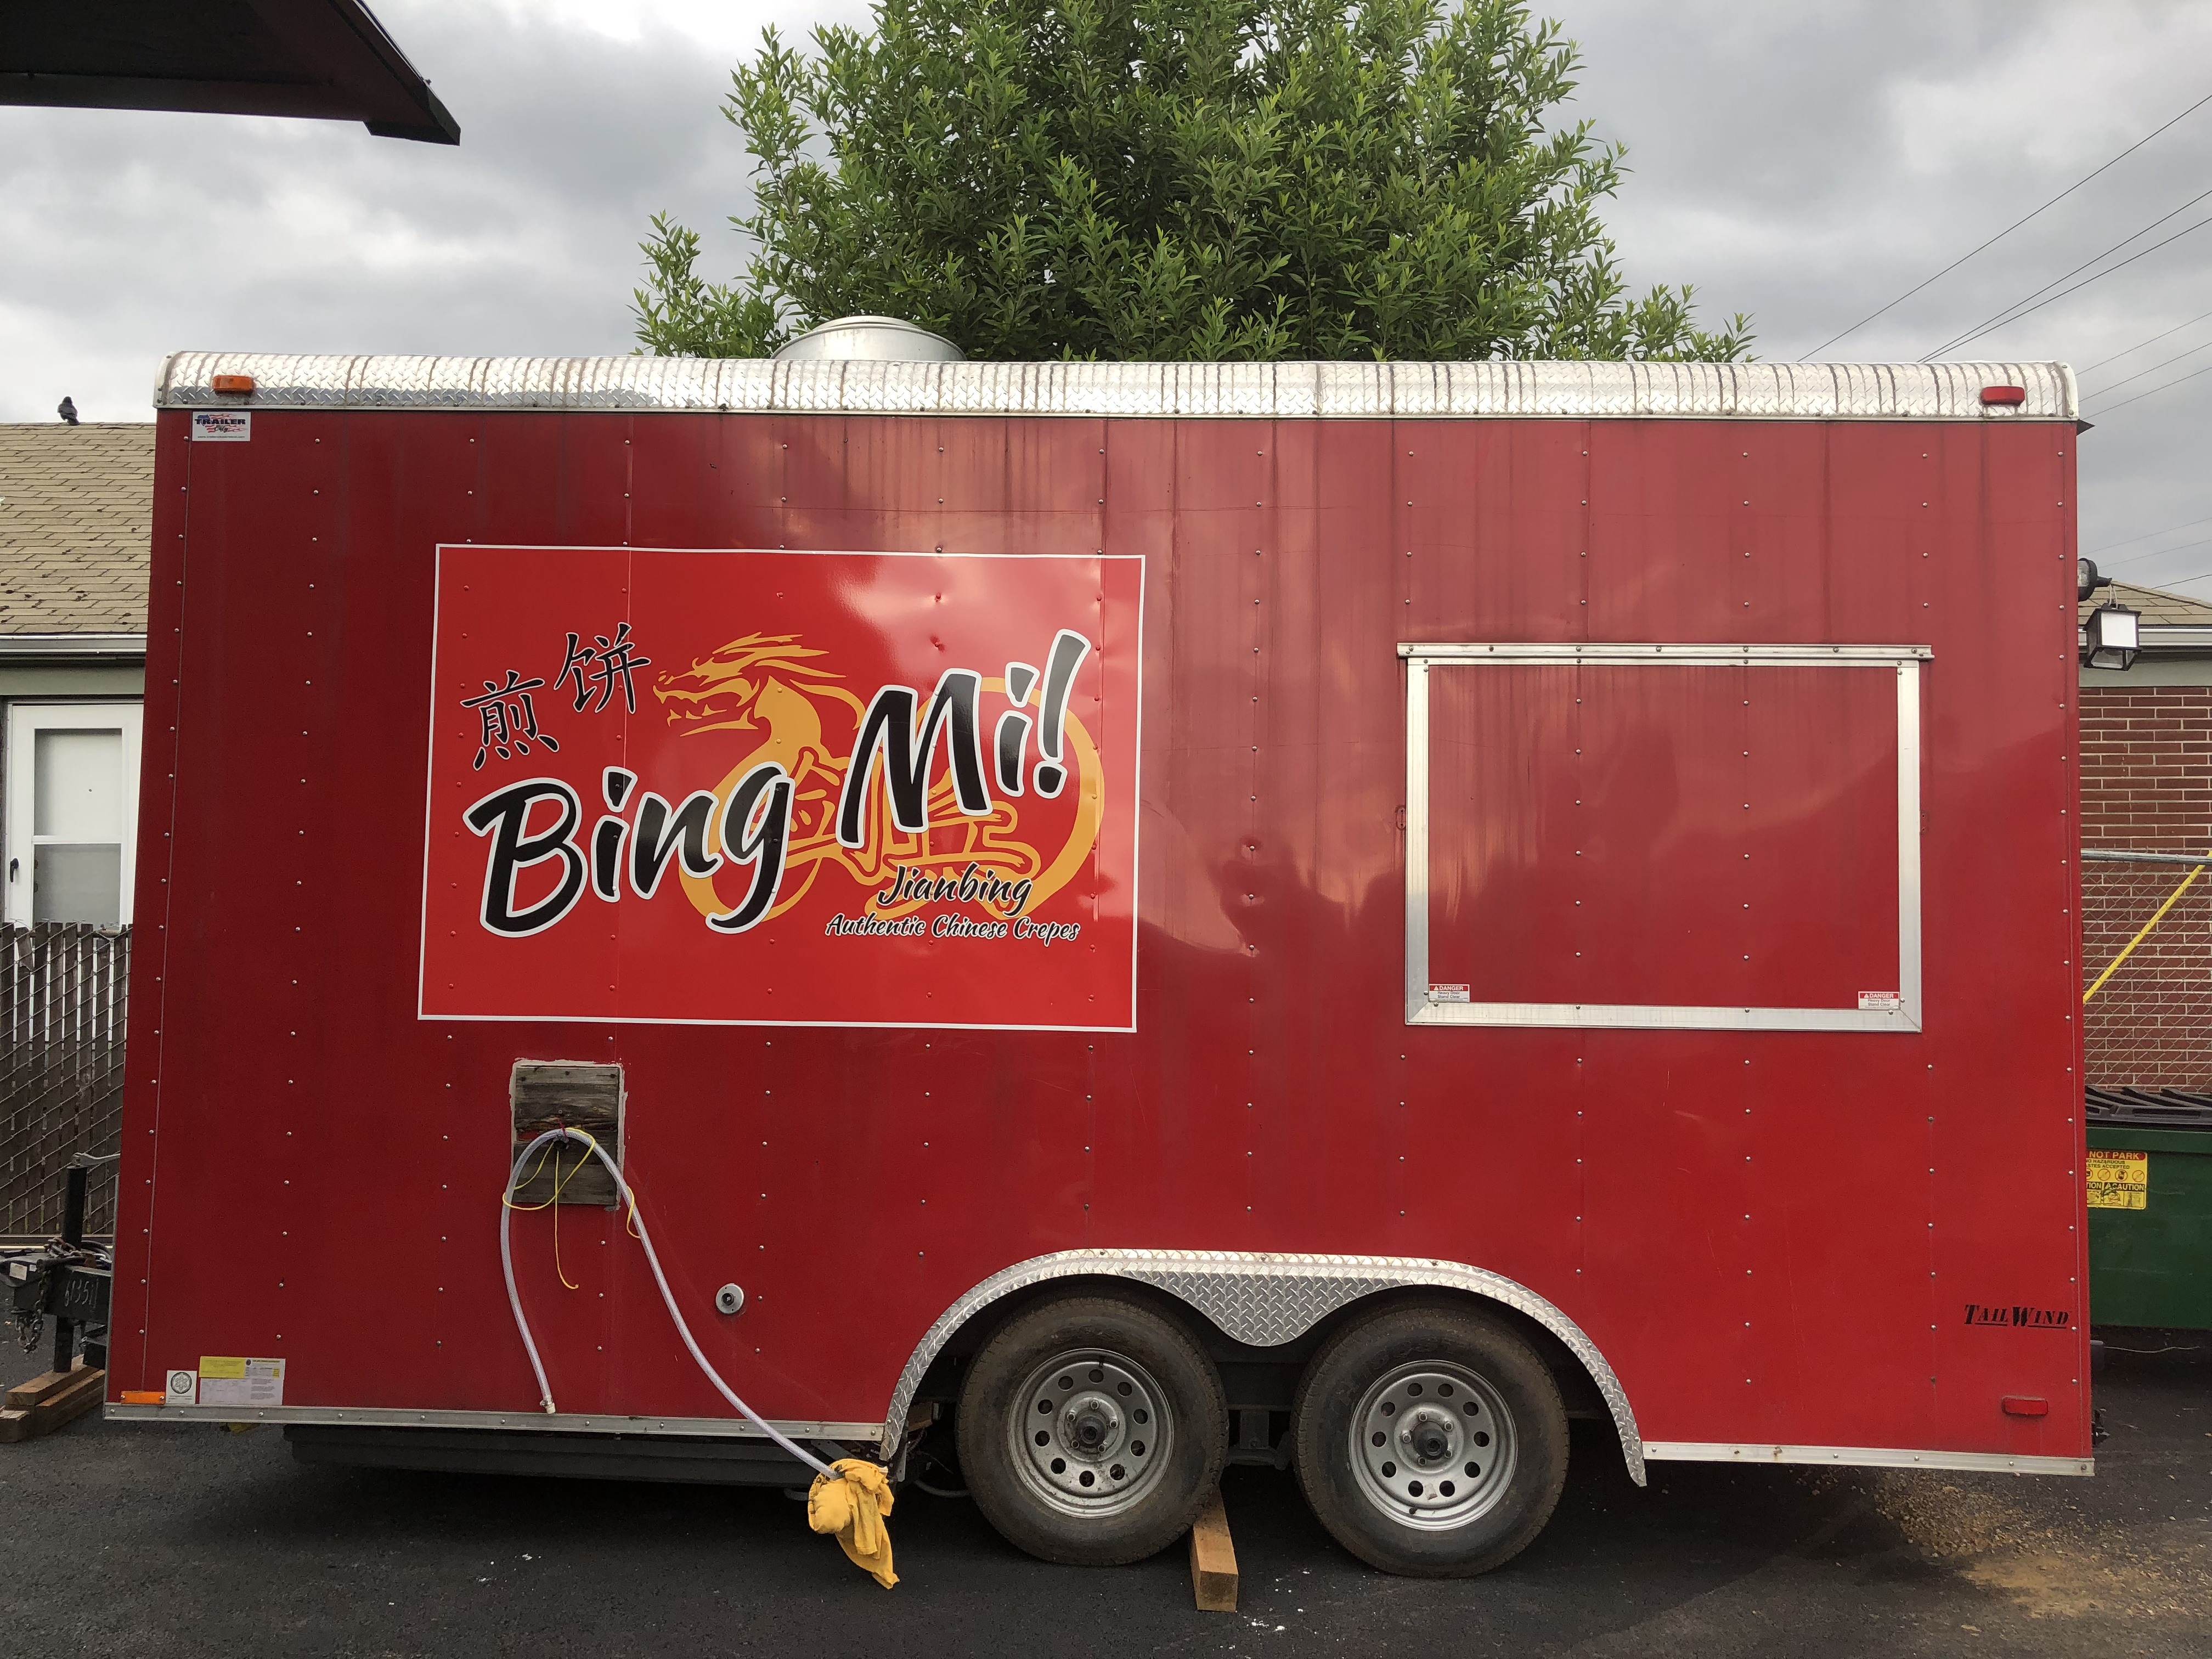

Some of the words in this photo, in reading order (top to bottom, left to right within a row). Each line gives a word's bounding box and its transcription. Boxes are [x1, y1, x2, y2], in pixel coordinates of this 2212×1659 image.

[463, 761, 795, 938] Bing
[836, 628, 1092, 848] Mi!
[877, 861, 1033, 917] Jianbing
[825, 912, 927, 936] Authentic
[931, 912, 1008, 940] Chinese
[1013, 917, 1081, 947] Crepes
[2089, 1150, 2110, 1159] NOT
[2112, 1152, 2140, 1160] PARK
